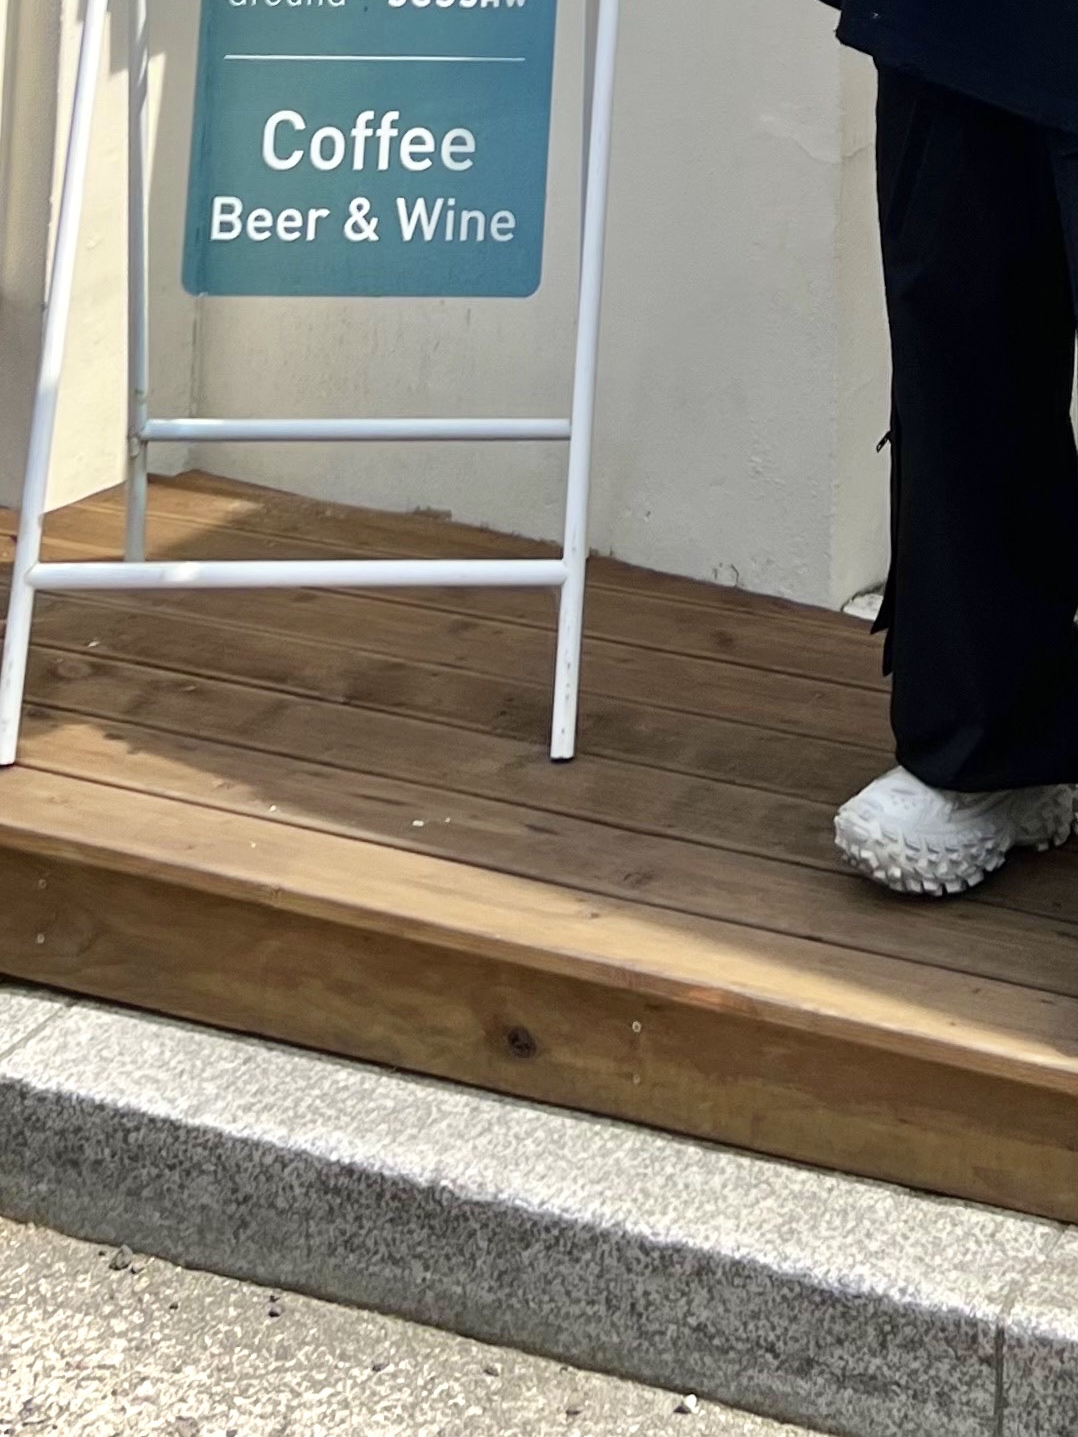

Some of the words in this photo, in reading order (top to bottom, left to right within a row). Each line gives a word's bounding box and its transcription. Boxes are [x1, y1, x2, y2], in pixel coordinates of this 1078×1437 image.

[262, 110, 476, 171] Coffee
[210, 195, 330, 242] Beer
[343, 197, 380, 242] &
[396, 197, 517, 243] Wine
